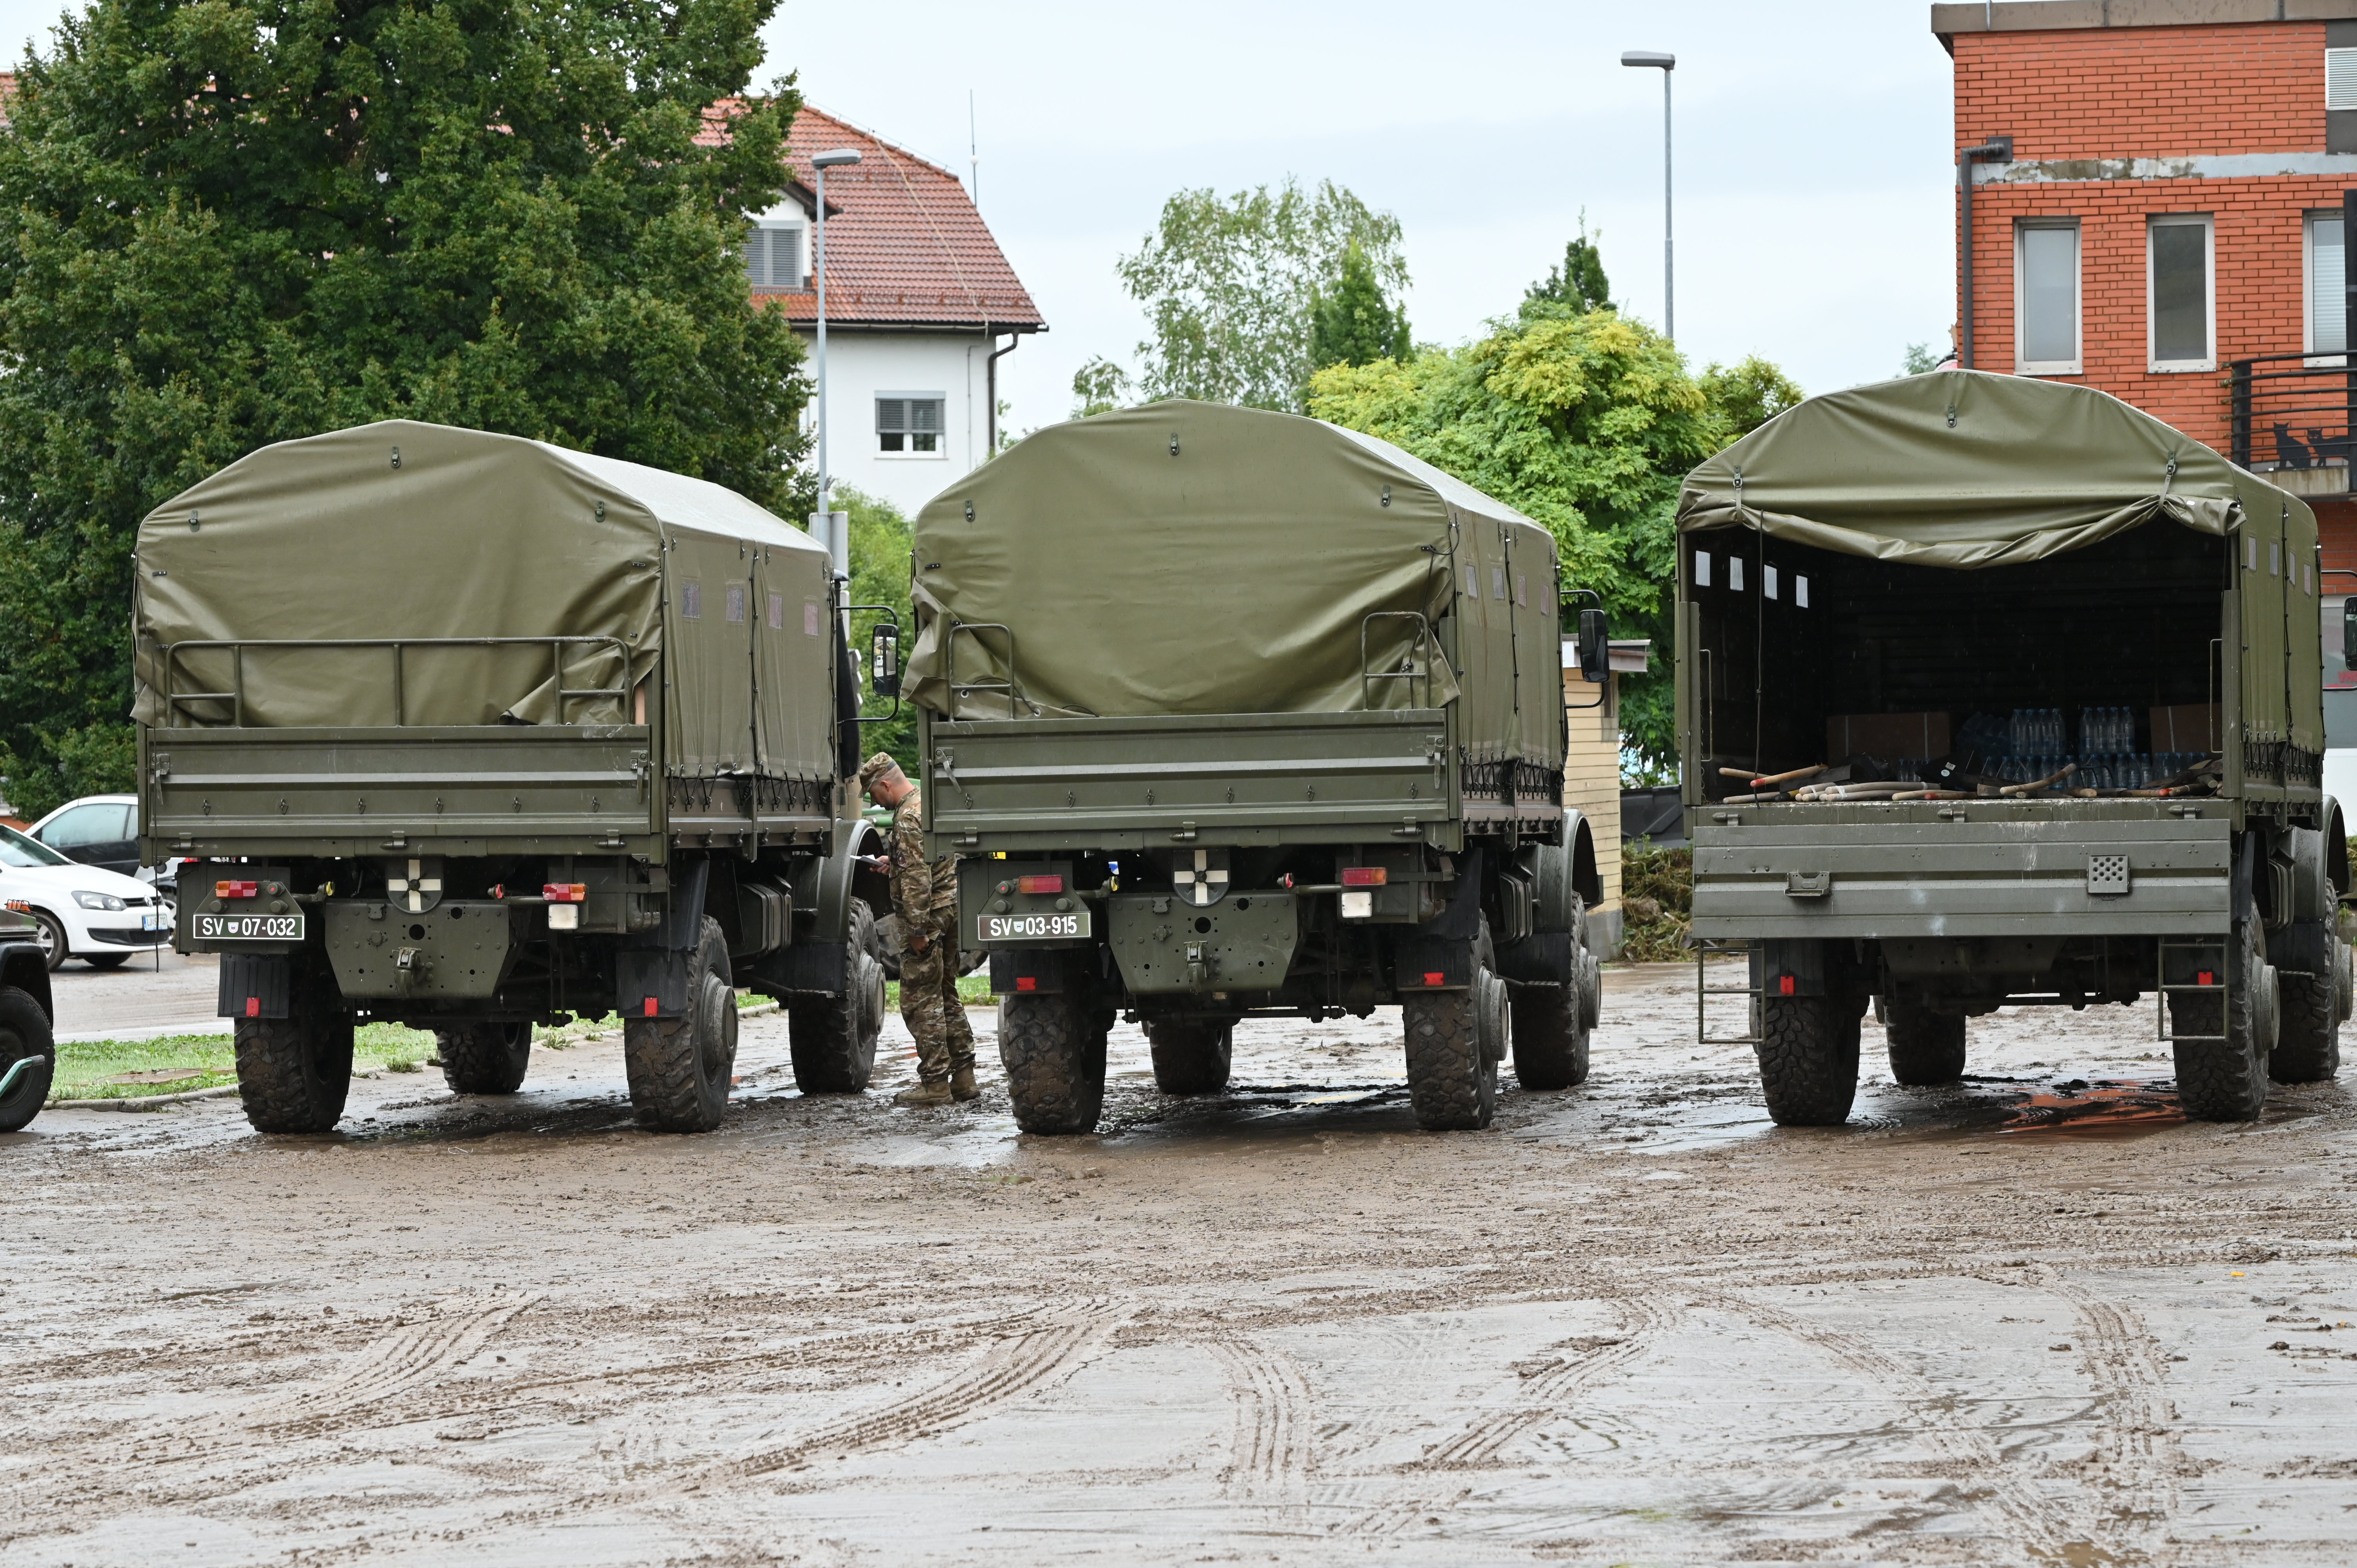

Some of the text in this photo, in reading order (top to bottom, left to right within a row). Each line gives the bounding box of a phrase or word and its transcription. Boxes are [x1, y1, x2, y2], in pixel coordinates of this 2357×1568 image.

[154, 917, 166, 926] S-733
[202, 918, 295, 936] SV 07-032
[990, 916, 1077, 936] SV 03-915
